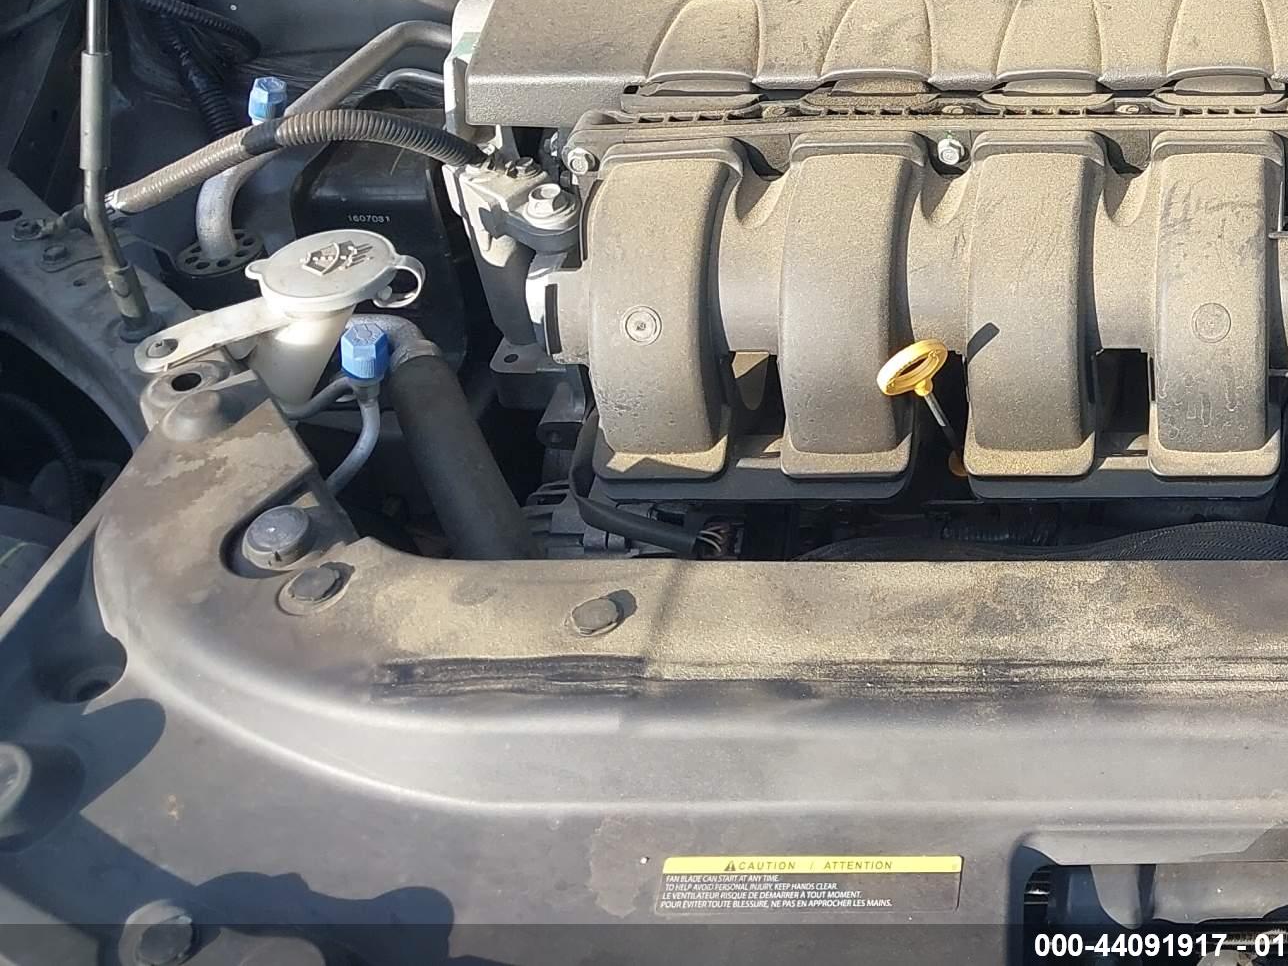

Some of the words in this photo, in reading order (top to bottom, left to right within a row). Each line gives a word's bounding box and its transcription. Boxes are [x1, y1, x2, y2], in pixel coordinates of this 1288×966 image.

[738, 862, 796, 870] CAUTION
[823, 861, 893, 870] ATTENTION
[666, 883, 675, 891] TO
[675, 883, 692, 891] HELP
[693, 883, 714, 891] AVOID
[748, 891, 758, 899] DE
[771, 899, 782, 907] NE
[782, 899, 796, 907] PAS
[797, 899, 807, 907] EN
[808, 899, 852, 907] APPROCHER
[853, 899, 865, 907] LES
